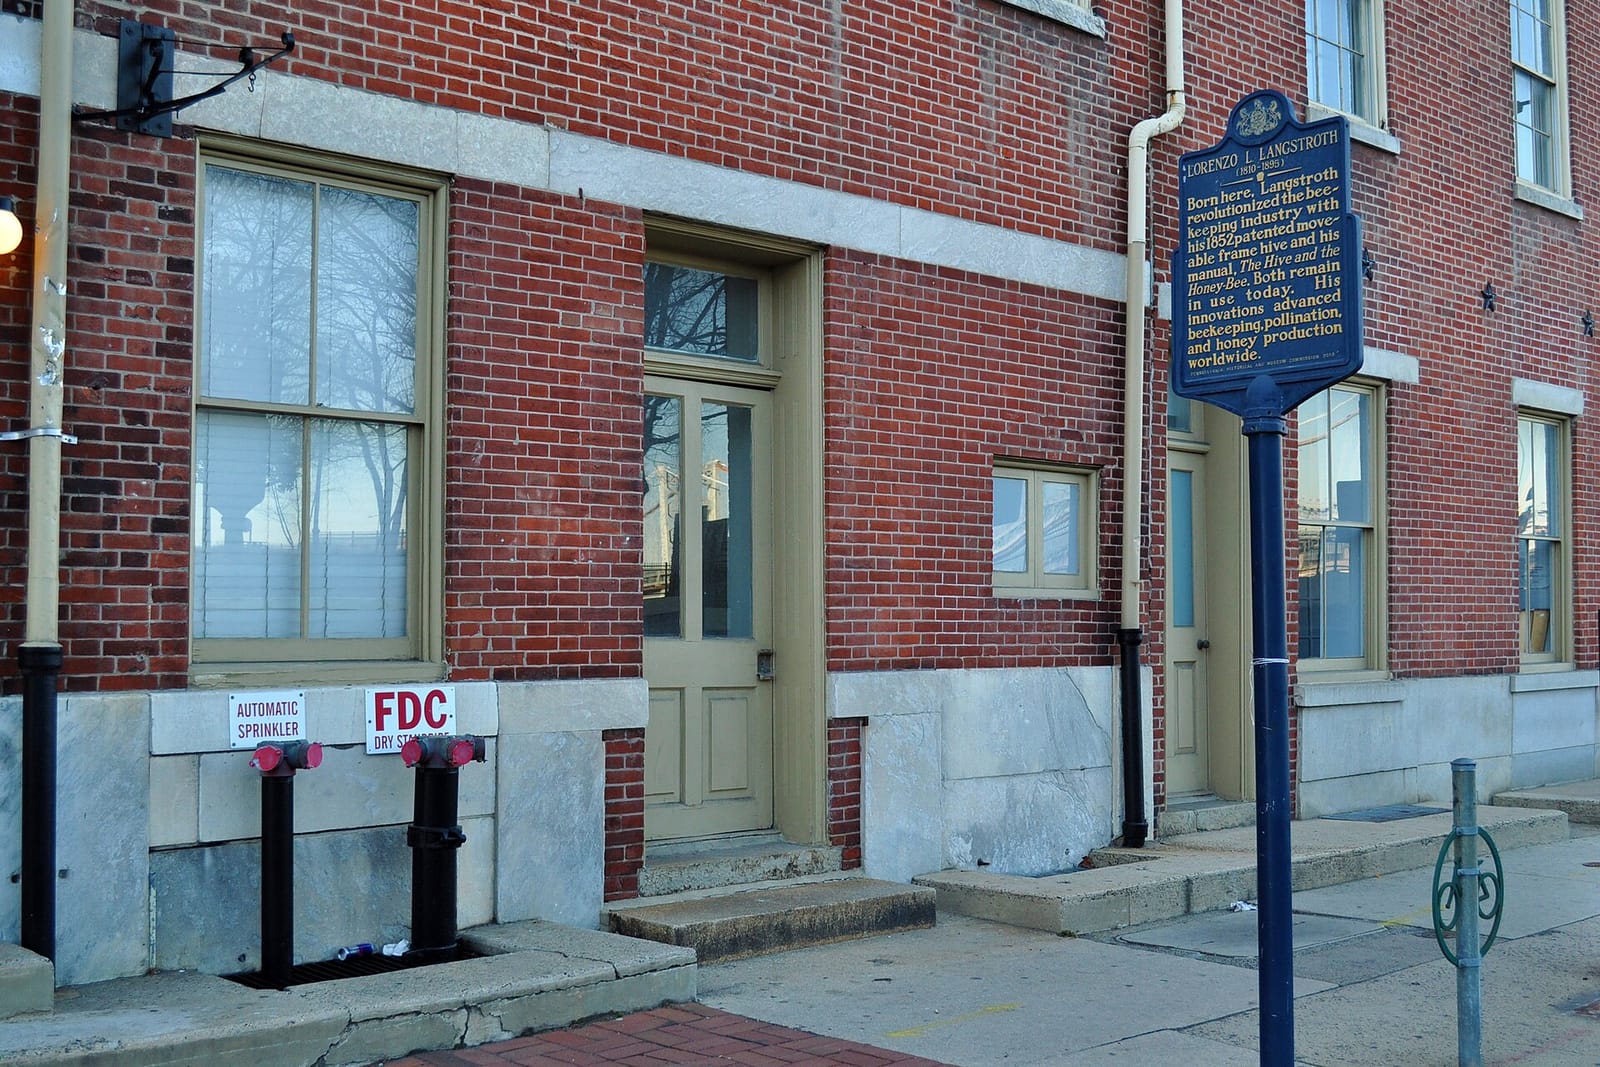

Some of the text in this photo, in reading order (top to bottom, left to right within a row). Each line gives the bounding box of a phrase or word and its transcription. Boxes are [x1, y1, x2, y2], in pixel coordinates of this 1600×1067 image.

[1187, 153, 1238, 178] LORENZO
[1259, 130, 1338, 161] LANGSTROTH
[1187, 195, 1218, 211] Born
[1260, 167, 1339, 195] Langstroth
[1187, 194, 1280, 225] revolutionized
[1281, 190, 1305, 205] the
[1187, 197, 1340, 239] keeping industry with
[1187, 240, 1205, 254] his
[1206, 233, 1234, 249] 1852
[1234, 220, 1295, 246] patented
[1188, 229, 1340, 268] able frame hive and his
[1240, 259, 1261, 273] The
[1264, 254, 1292, 270] Hive
[1295, 246, 1318, 263] and
[1321, 244, 1340, 258] the
[1253, 269, 1286, 285] Both
[1290, 260, 1340, 279] remain
[1188, 275, 1341, 312] in use today. His
[1188, 289, 1341, 326] innovations advanced
[1265, 306, 1342, 332] pollination,
[1187, 322, 1343, 355] and honey production
[1188, 349, 1261, 369] worldwide.
[237, 701, 298, 718] AUTOMATIC
[374, 689, 447, 731] FDC
[238, 722, 299, 739] SPRINKLER
[374, 735, 394, 750] DRY
